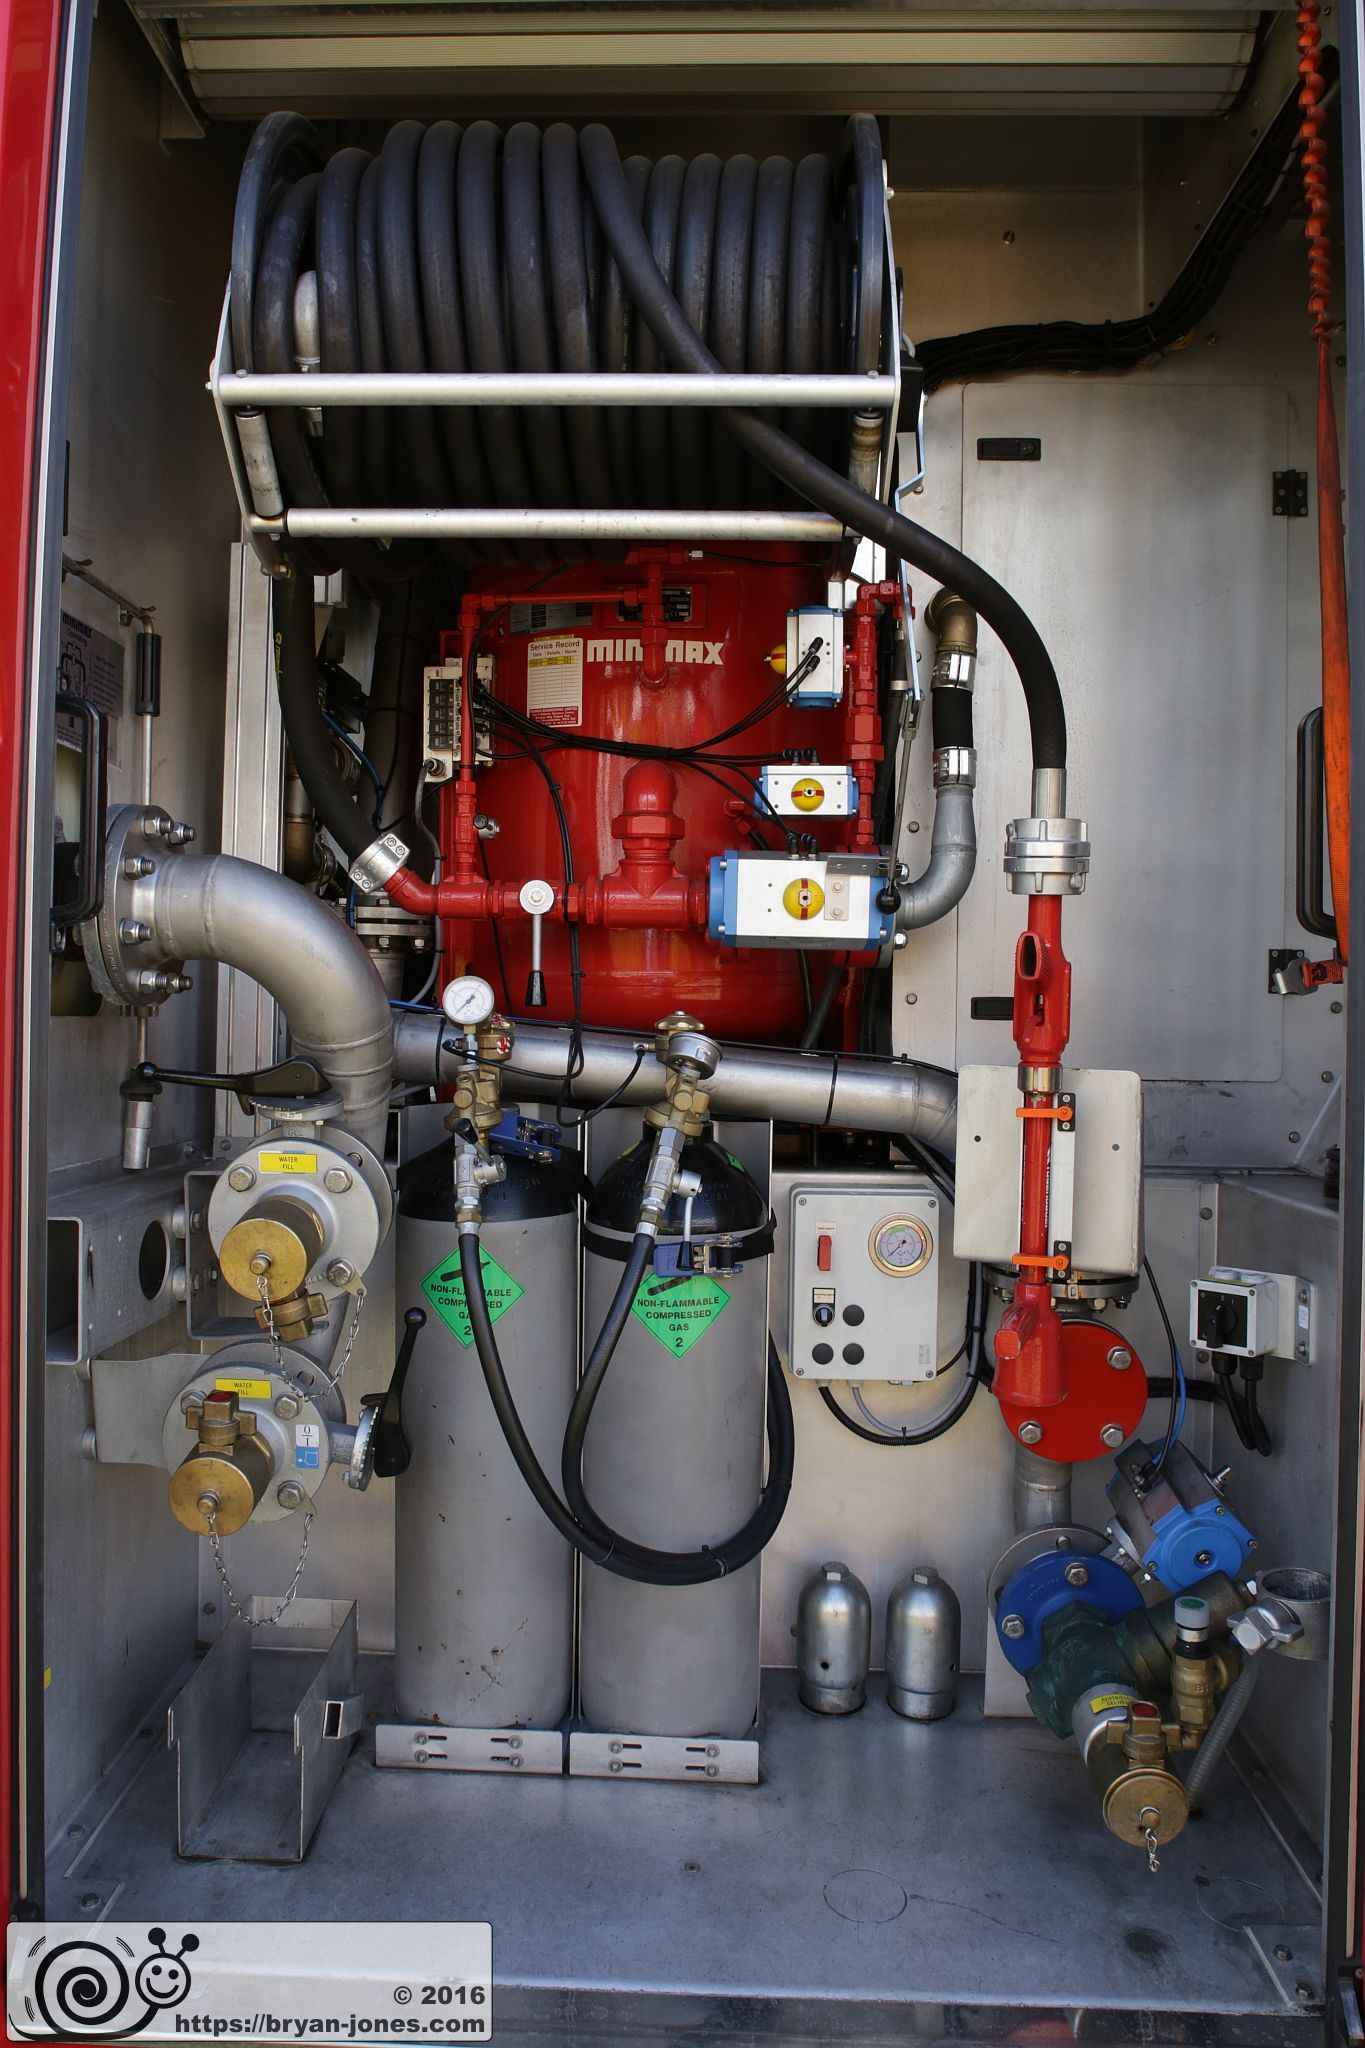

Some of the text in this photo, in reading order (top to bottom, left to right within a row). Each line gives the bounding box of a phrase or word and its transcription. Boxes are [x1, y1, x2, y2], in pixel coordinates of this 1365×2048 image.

[530, 640, 580, 651] Service Record
[637, 1296, 720, 1308] NON-FLAMMABLE
[646, 1309, 712, 1319] COMPRESSED
[464, 1325, 472, 1336] 2
[668, 1323, 690, 1331] GAS
[675, 1337, 684, 1348] 2
